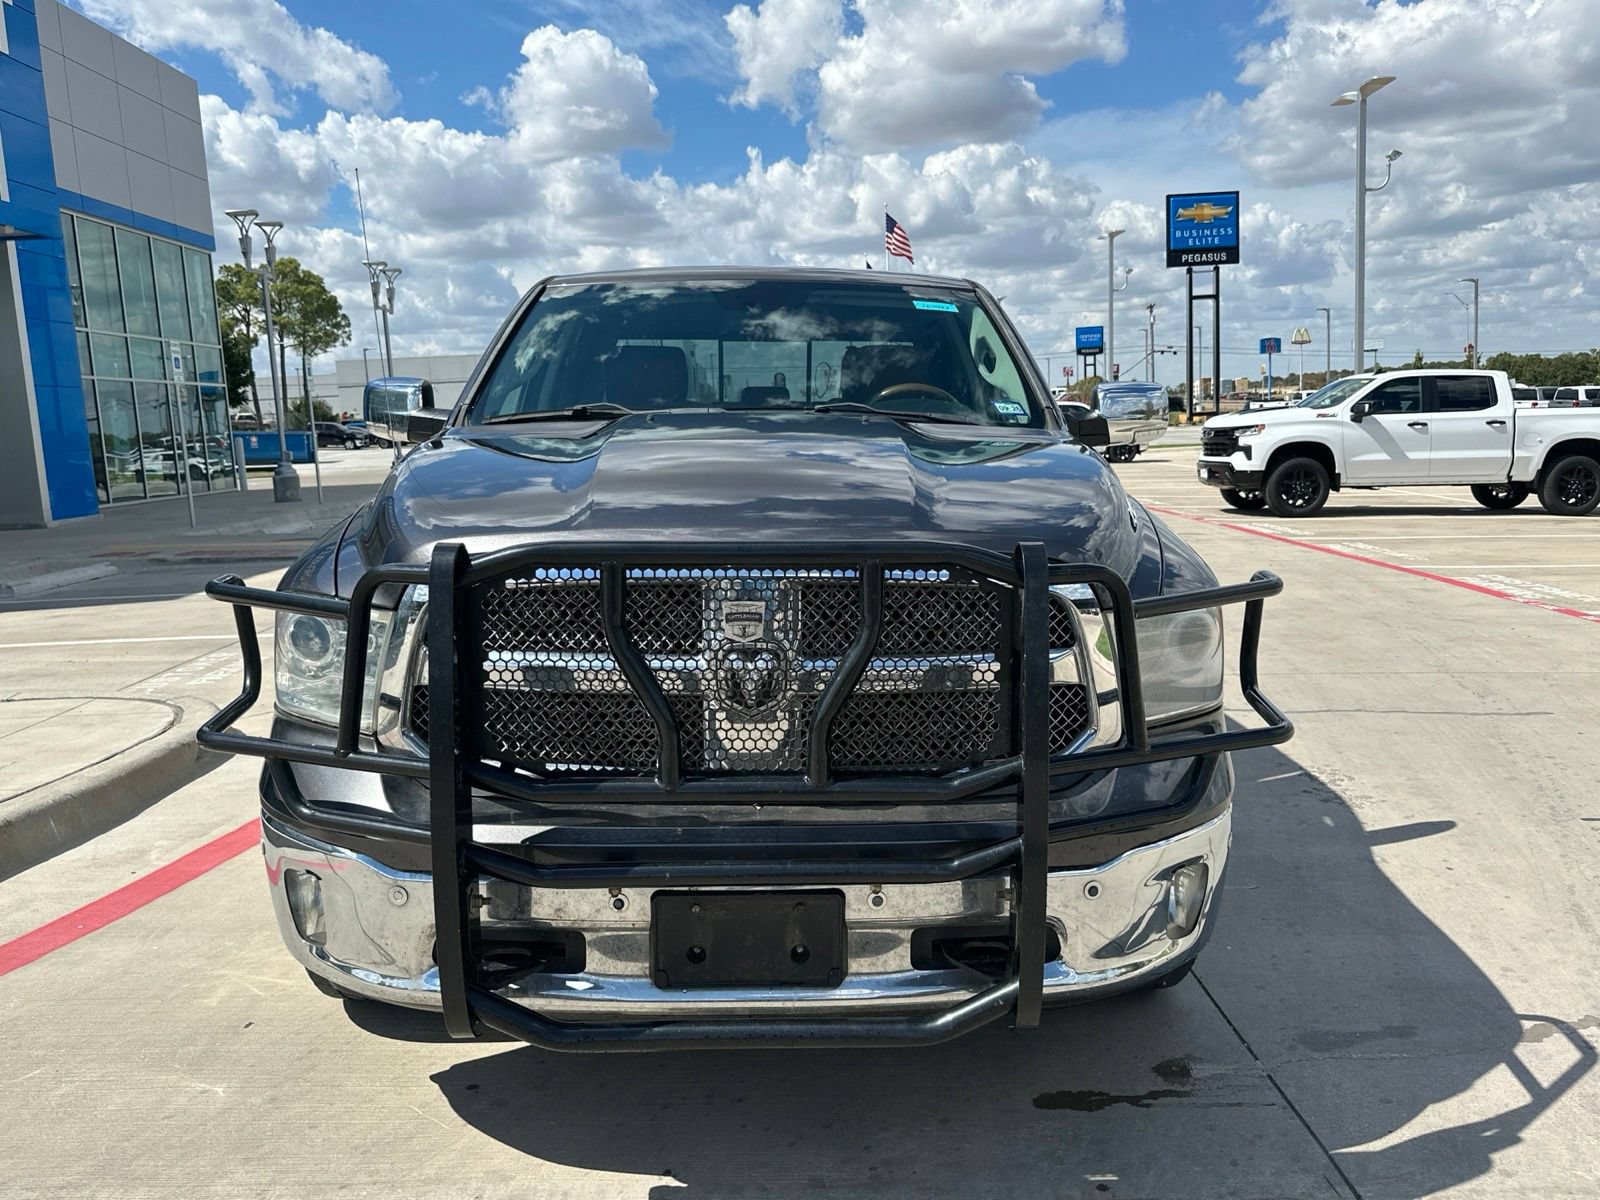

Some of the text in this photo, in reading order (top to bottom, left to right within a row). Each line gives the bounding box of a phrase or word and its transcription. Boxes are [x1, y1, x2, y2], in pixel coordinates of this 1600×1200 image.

[1175, 227, 1233, 237] BUSINESS
[1188, 237, 1220, 246] ELITE
[1181, 252, 1227, 263] PEGASUS
